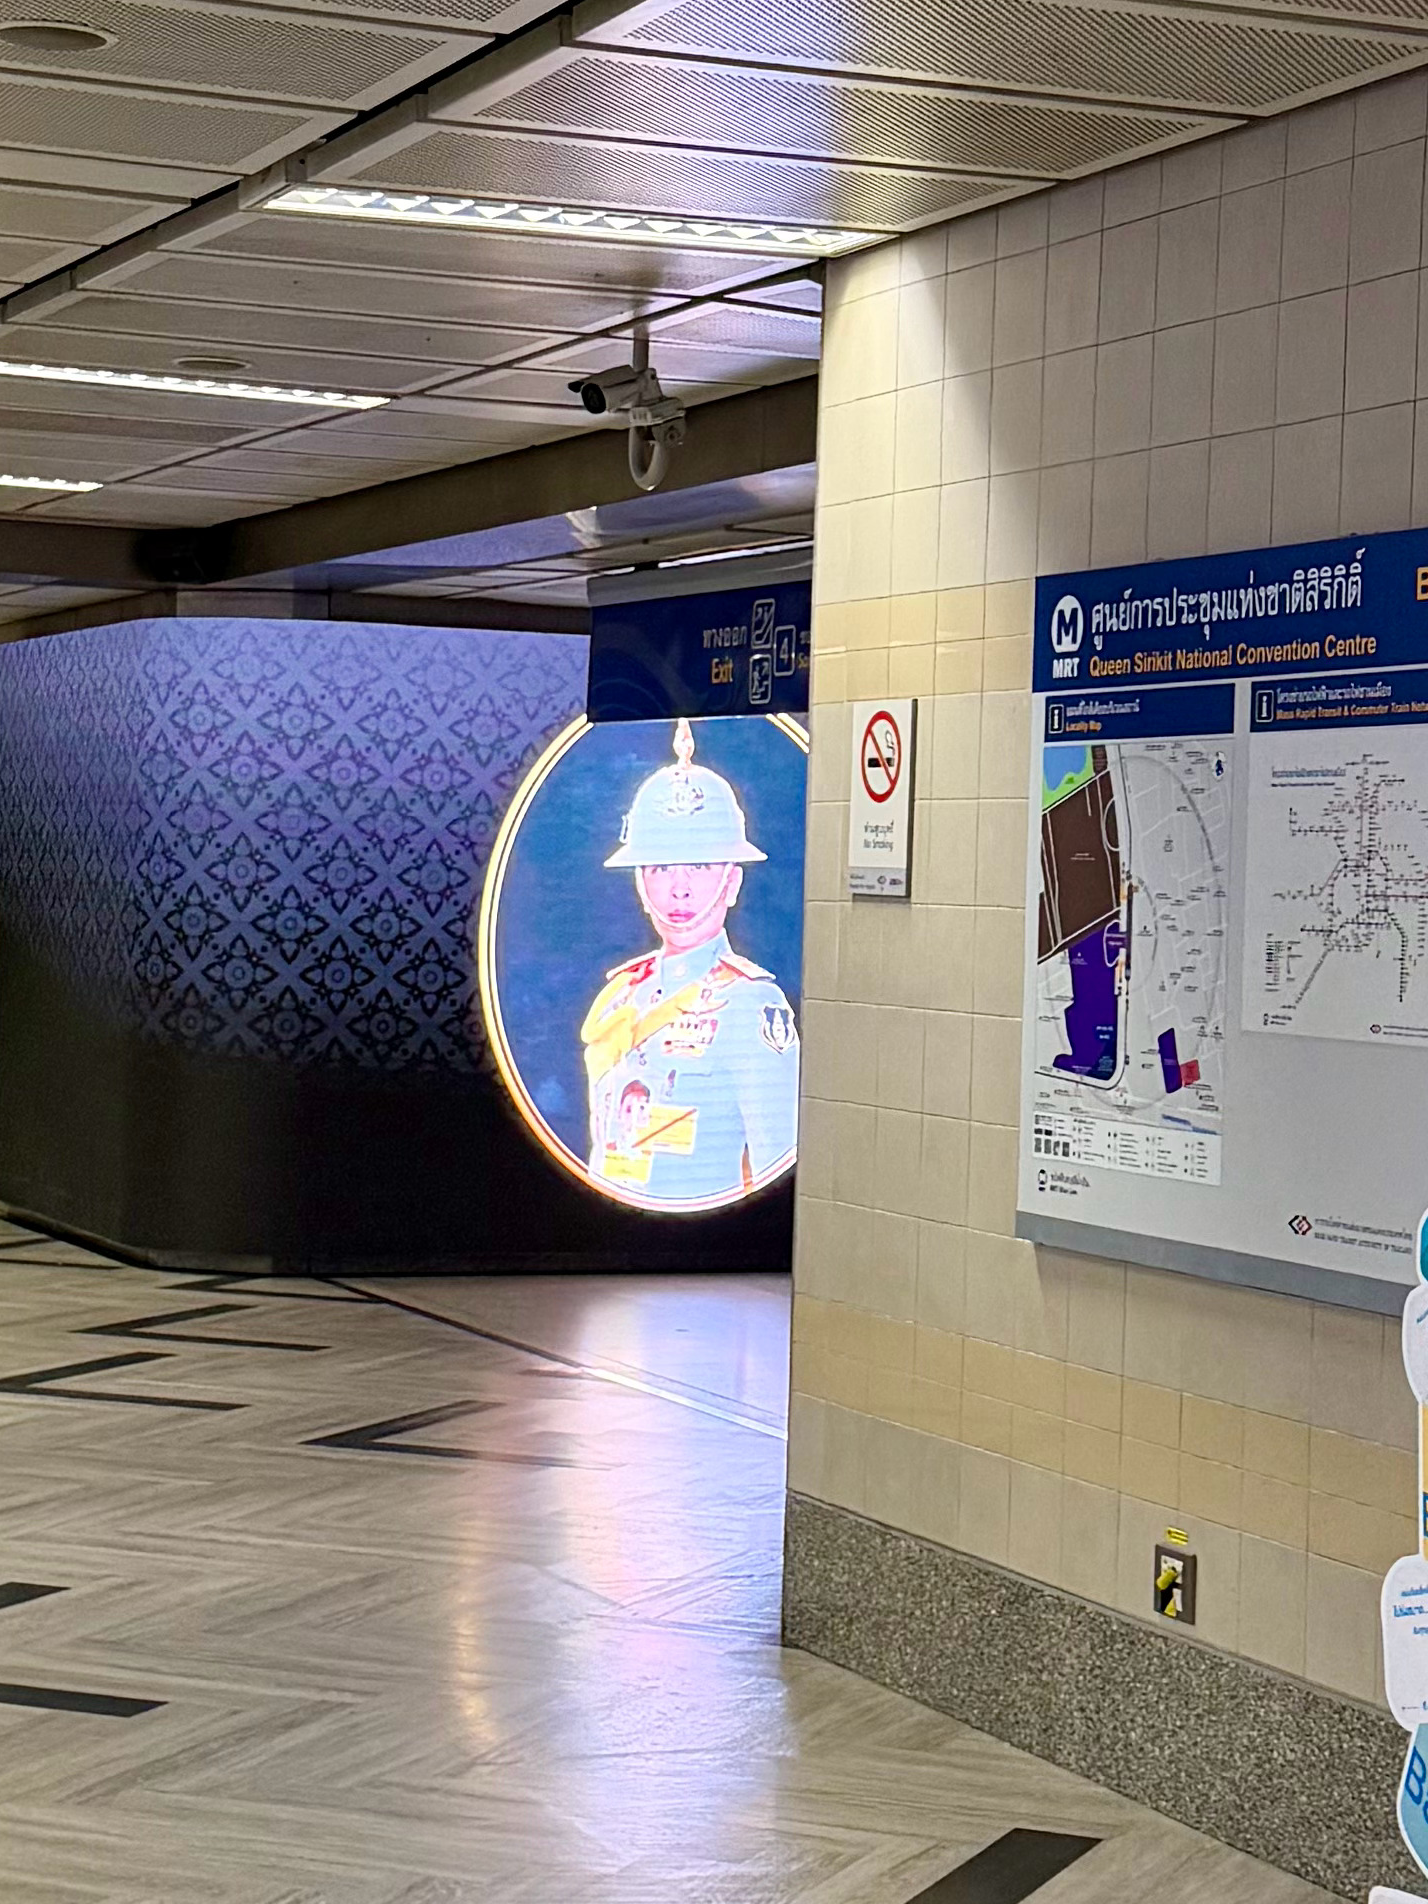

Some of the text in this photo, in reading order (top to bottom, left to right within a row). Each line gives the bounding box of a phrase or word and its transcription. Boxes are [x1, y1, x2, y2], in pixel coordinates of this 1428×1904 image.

[1090, 547, 1366, 650] ศูนย์การประชุมแห่งชาติสิริกิติ์
[779, 637, 789, 664] 4
[1089, 633, 1377, 678] Queen Sirikit National Convention Centre
[712, 656, 733, 684] Exit
[1052, 657, 1080, 679] MRT
